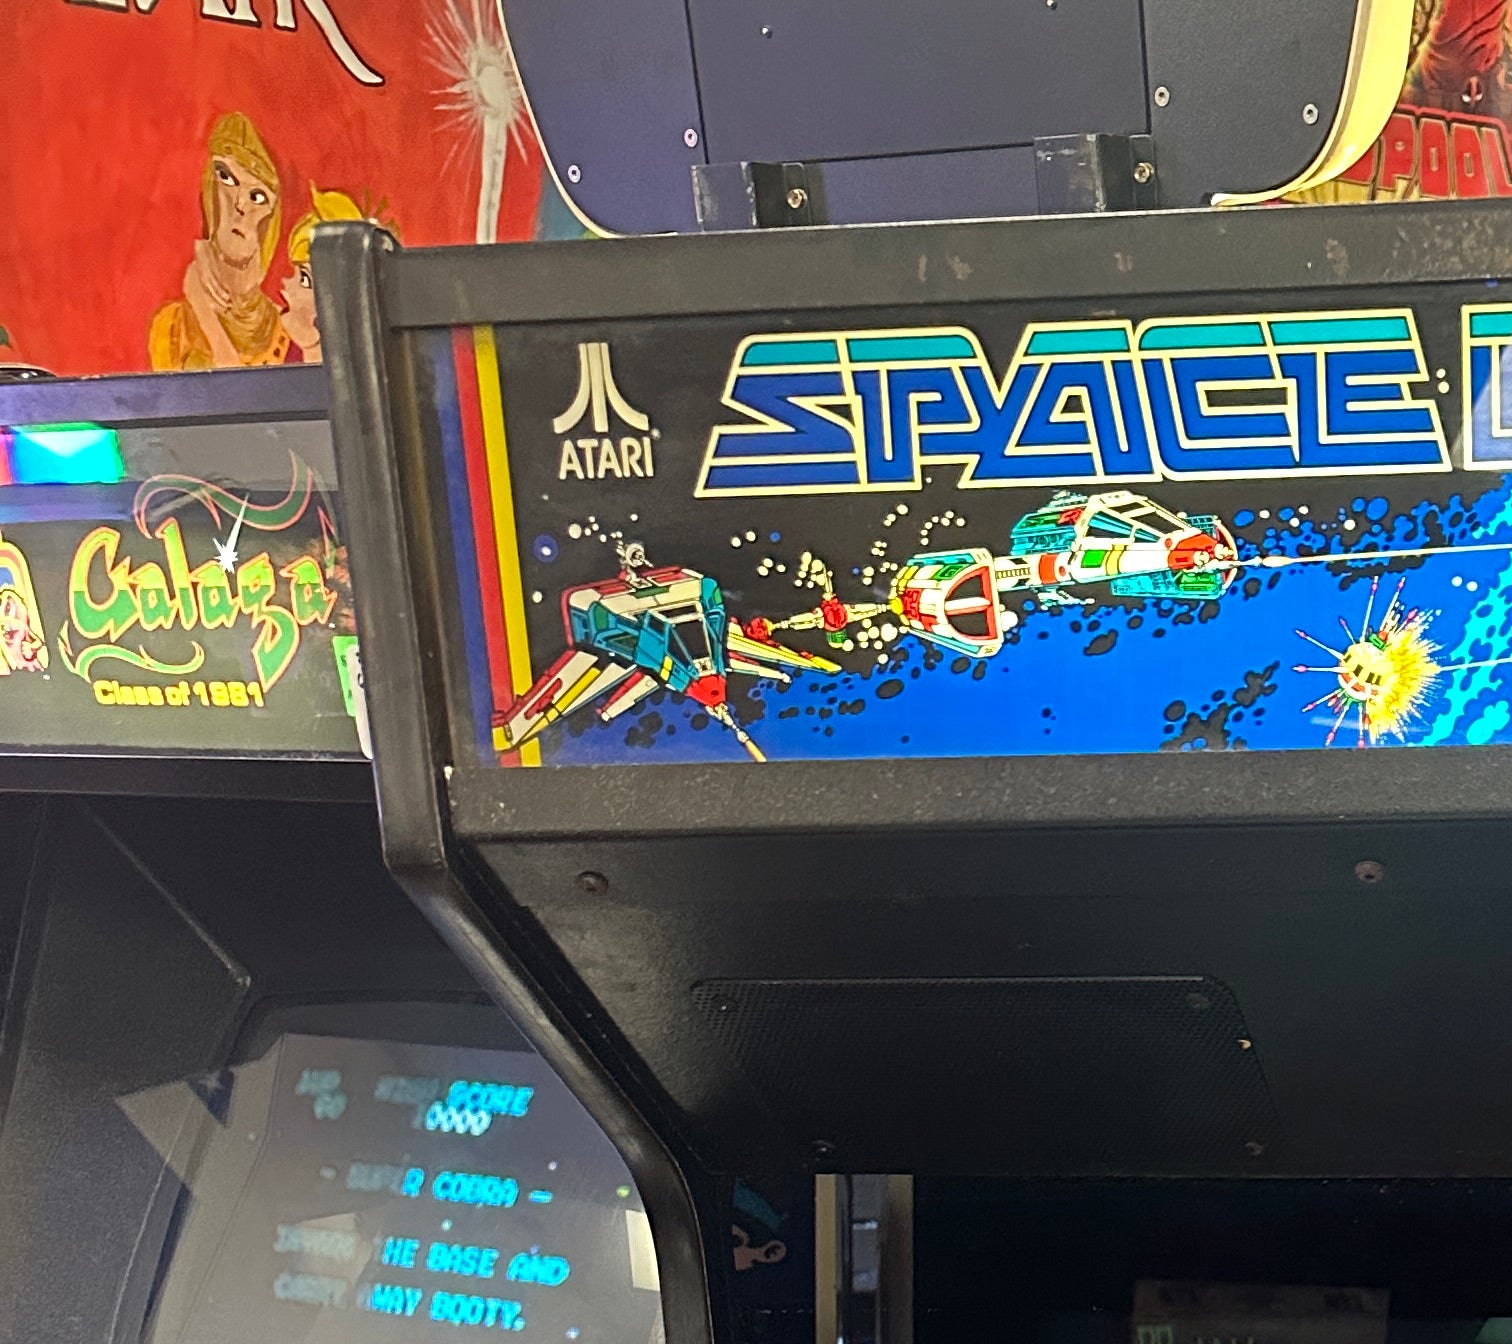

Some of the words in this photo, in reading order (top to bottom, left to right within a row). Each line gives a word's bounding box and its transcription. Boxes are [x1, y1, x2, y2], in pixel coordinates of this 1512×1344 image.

[694, 308, 1452, 498] SPACE
[558, 436, 655, 480] ATARI
[69, 517, 338, 692] Galaga
[94, 680, 164, 705] Class
[166, 680, 191, 705] of
[193, 681, 264, 707] 1981
[427, 1242, 499, 1278] BASE
[507, 1253, 570, 1286] AND
[430, 1291, 526, 1331] BOOTY.
